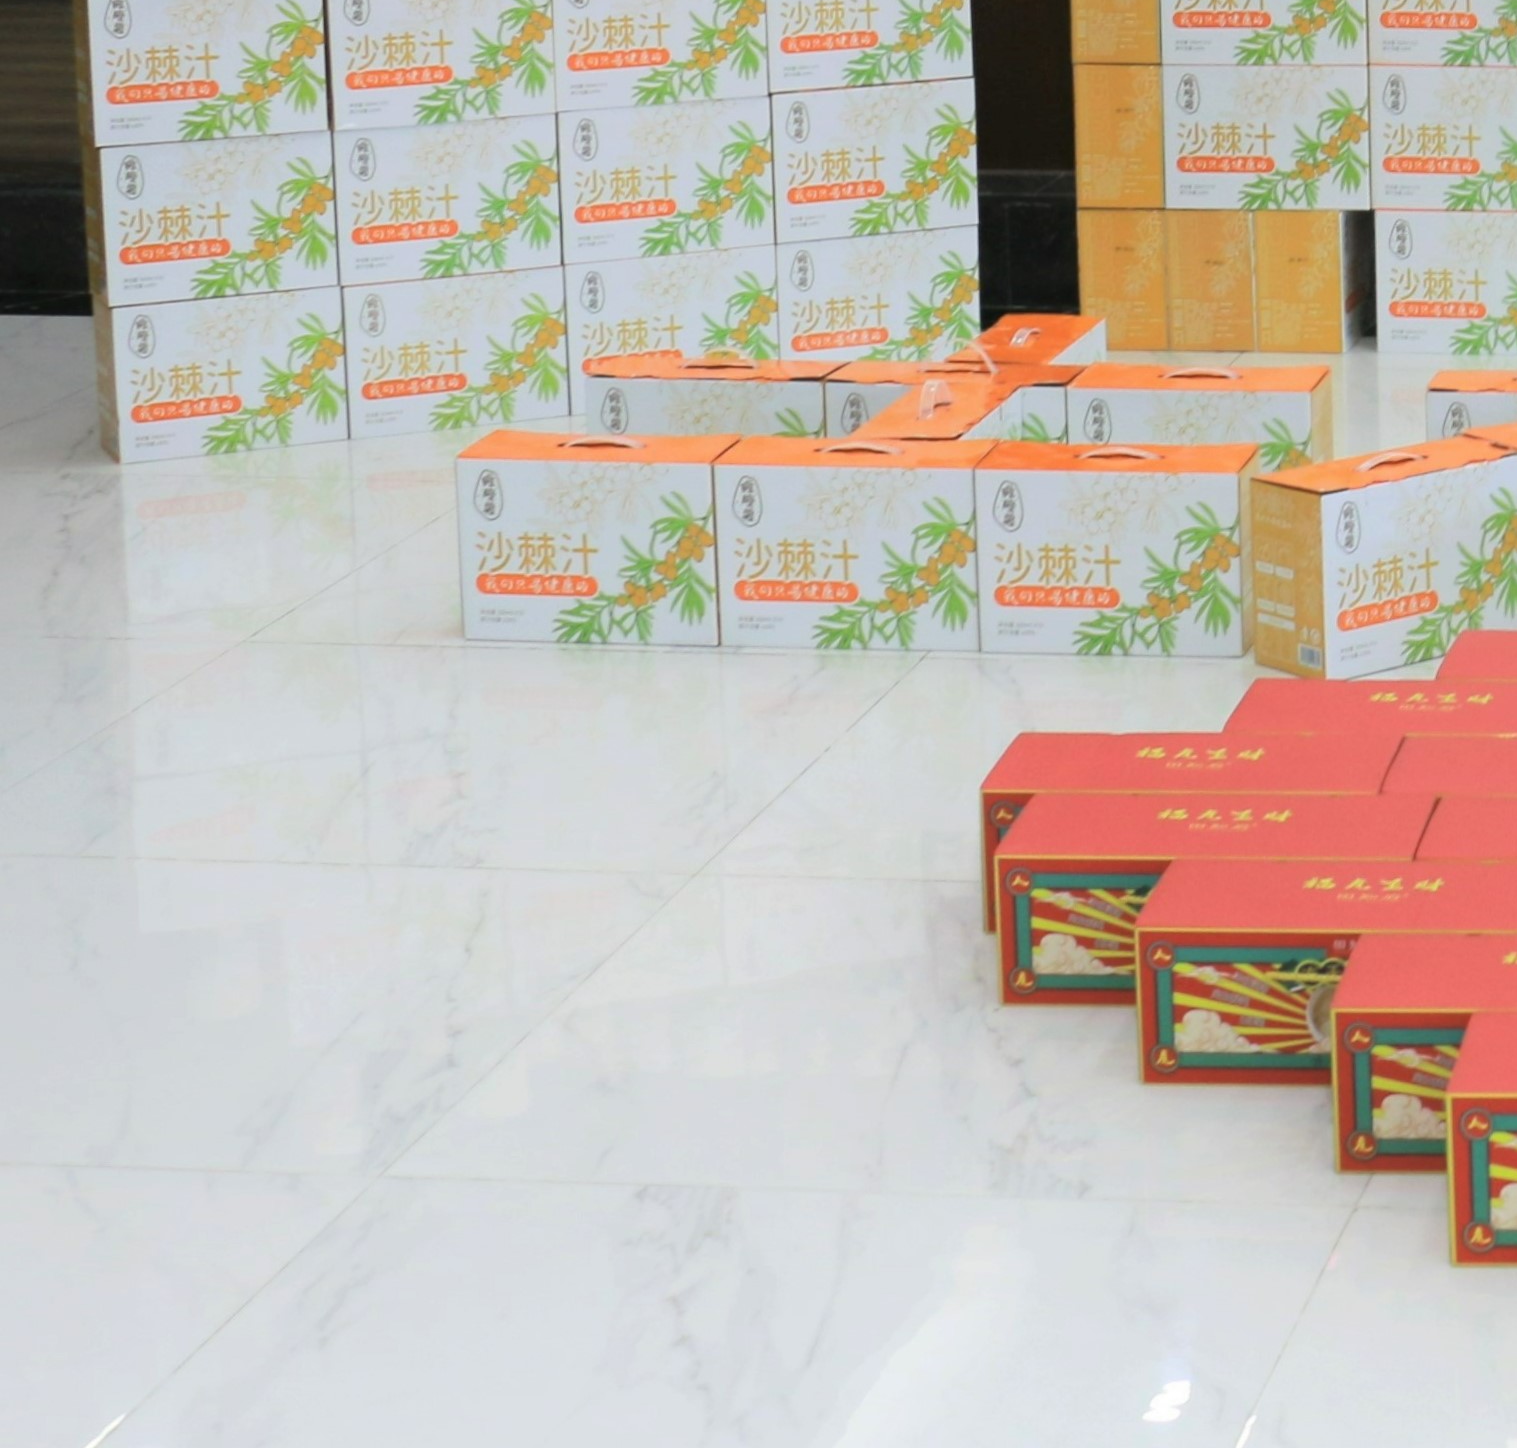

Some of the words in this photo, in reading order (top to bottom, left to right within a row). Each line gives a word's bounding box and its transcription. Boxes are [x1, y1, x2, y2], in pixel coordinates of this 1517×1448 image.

[568, 15, 670, 52] 沙棘汁
[781, 0, 879, 36] 沙棘汁
[107, 44, 219, 84] 沙棘汁
[346, 30, 453, 70] 沙棘汁
[1177, 123, 1275, 158] 沙棘汁
[1383, 125, 1480, 160] 沙棘汁
[575, 166, 677, 204] 沙棘汁
[788, 149, 885, 186] 沙棘汁
[120, 202, 231, 244] 沙棘汁
[352, 184, 459, 225] 沙棘汁
[1389, 270, 1486, 304] 沙棘汁
[581, 314, 684, 357] 沙棘汁
[792, 297, 888, 334] 沙棘汁
[362, 339, 467, 380] 沙棘汁
[132, 359, 242, 403] 沙棘汁
[476, 533, 598, 578] 沙棘汁
[735, 540, 859, 584] 沙棘汁
[995, 544, 1120, 590] 沙棘汁
[1338, 552, 1439, 612] 沙棘汁
